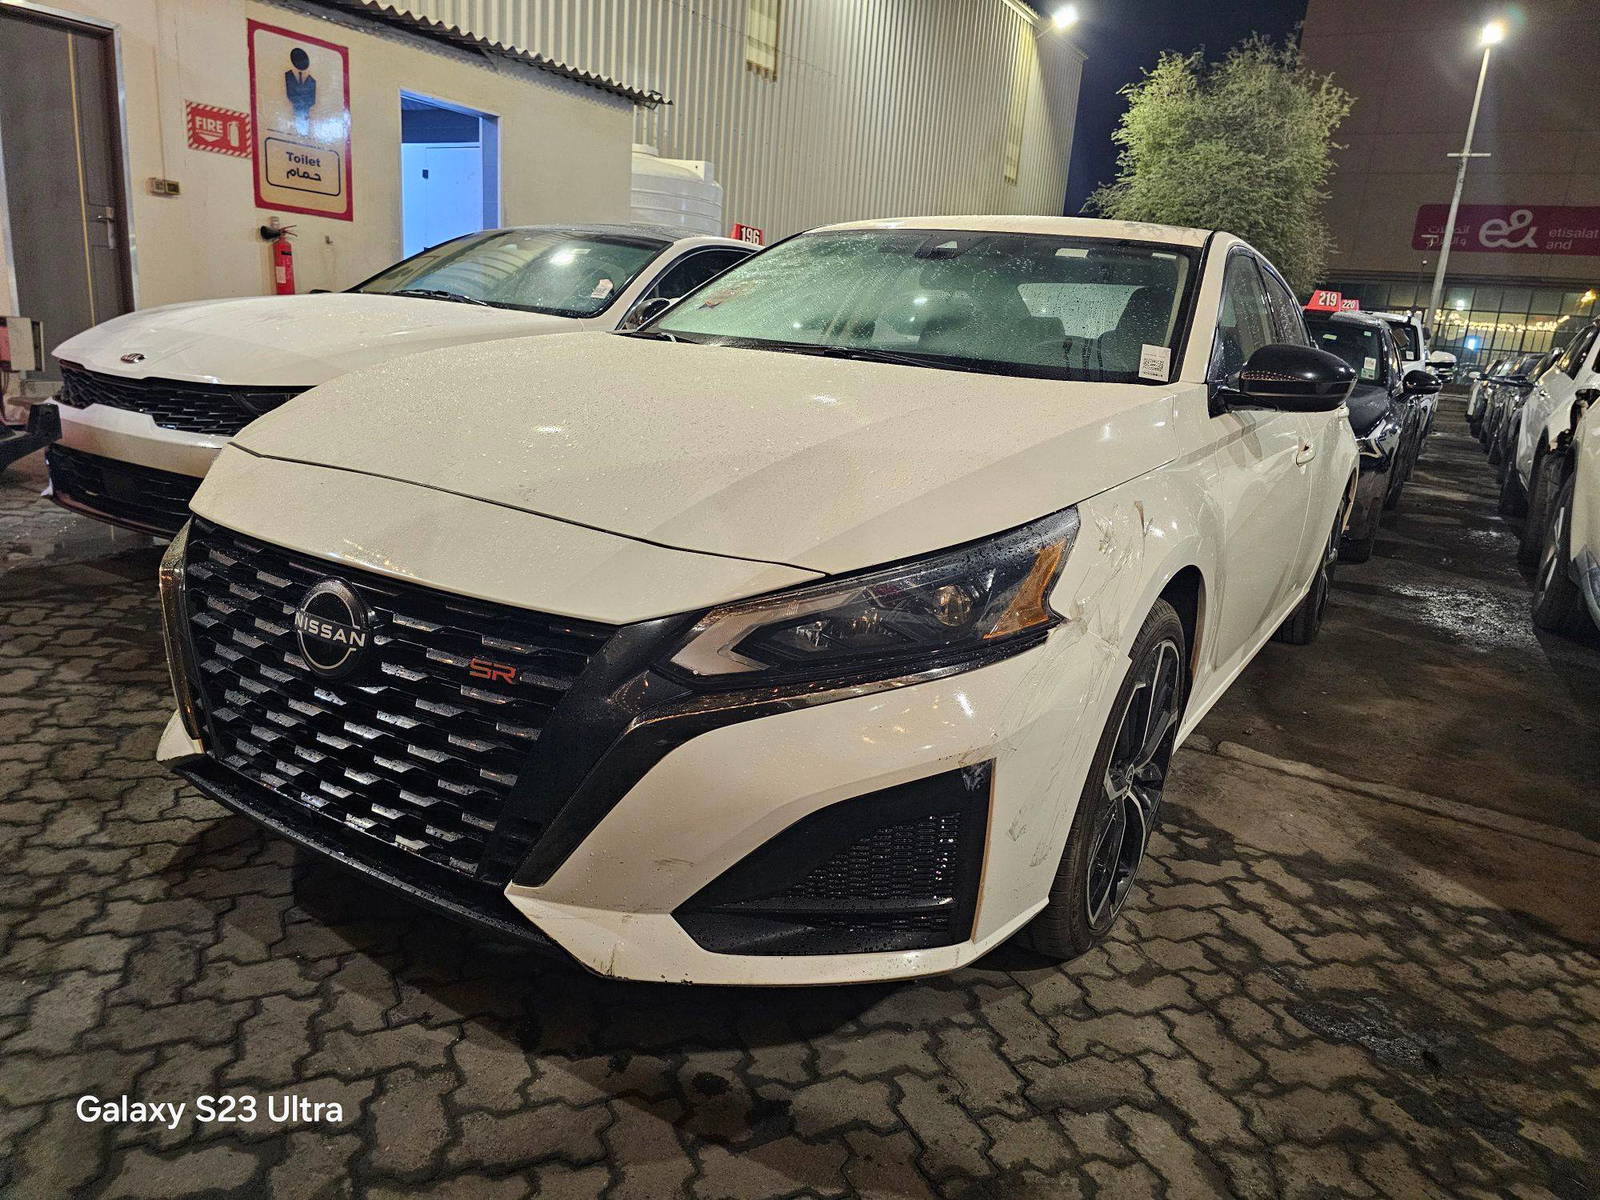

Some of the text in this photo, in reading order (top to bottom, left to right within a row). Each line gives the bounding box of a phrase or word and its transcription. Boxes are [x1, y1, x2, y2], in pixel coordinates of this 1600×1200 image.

[195, 116, 224, 134] FIRE
[286, 151, 321, 168] Toilet
[286, 167, 322, 182] حمام
[741, 226, 760, 246] 196
[1479, 209, 1538, 248] e&
[1546, 239, 1572, 250] and
[1318, 292, 1337, 306] 219
[294, 614, 365, 647] NISSAN
[469, 657, 516, 684] SR
